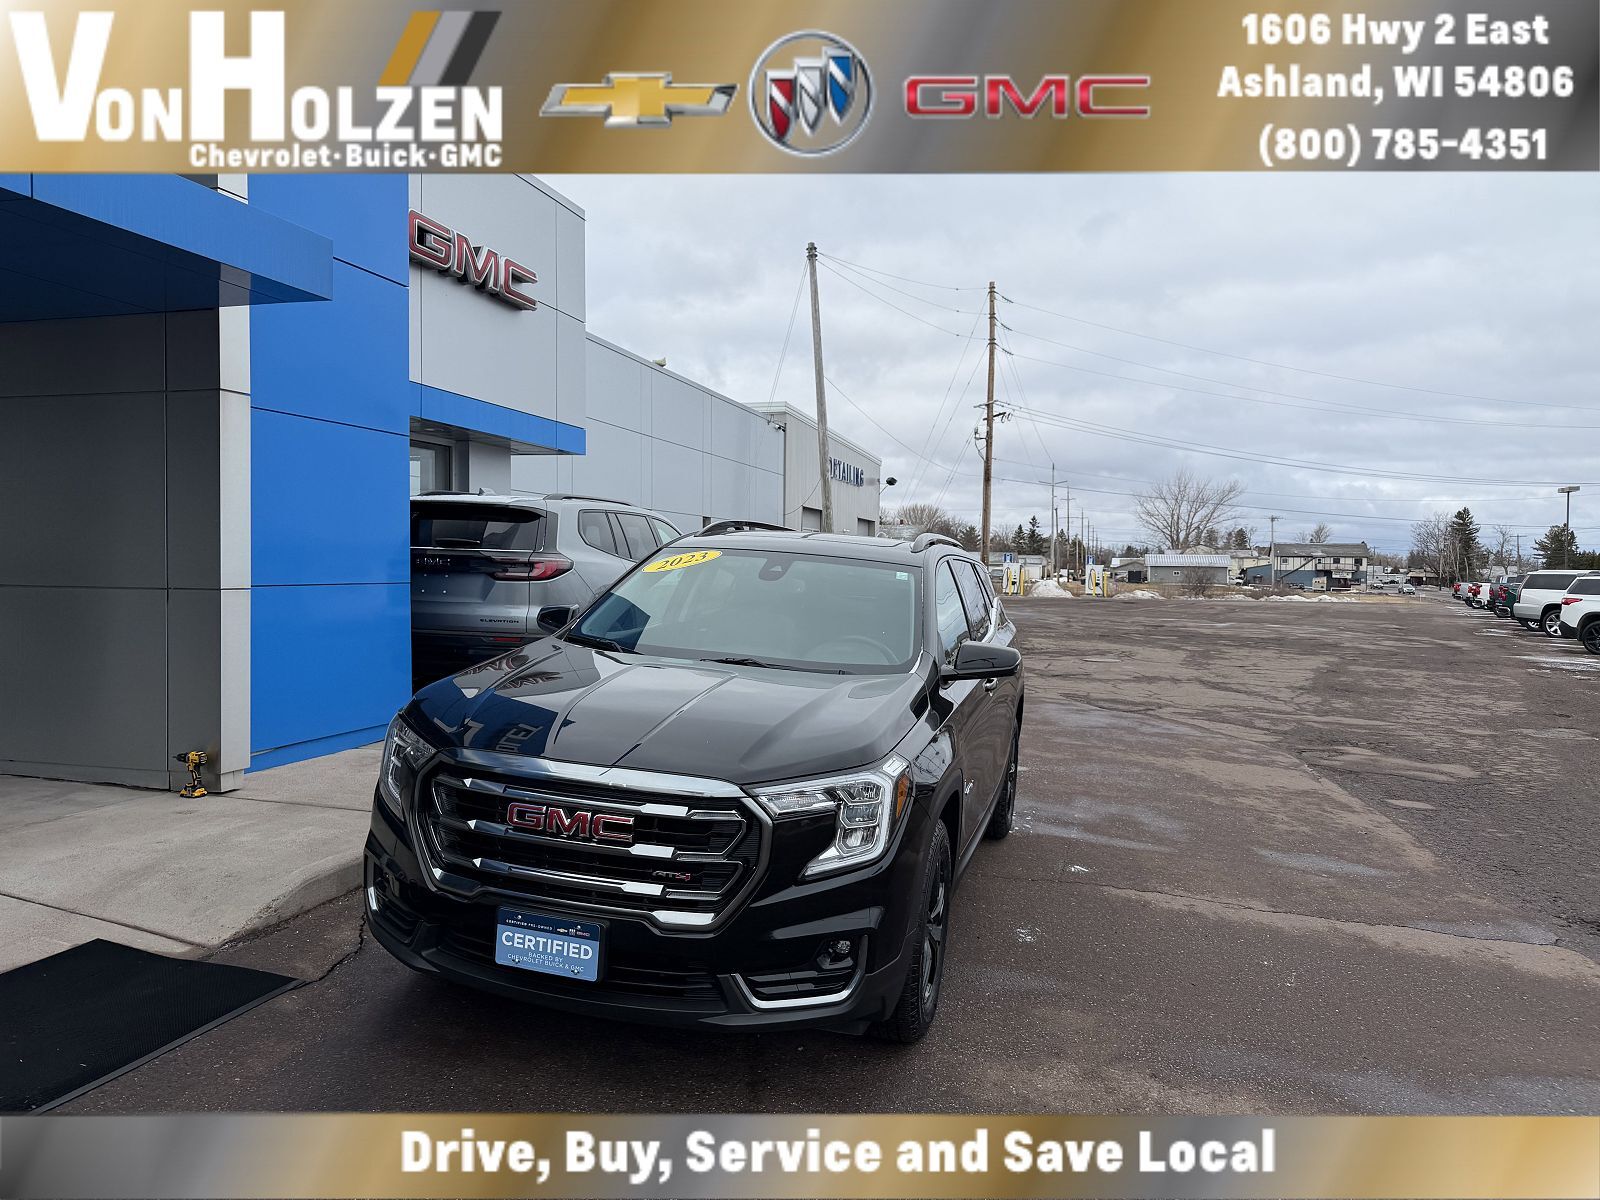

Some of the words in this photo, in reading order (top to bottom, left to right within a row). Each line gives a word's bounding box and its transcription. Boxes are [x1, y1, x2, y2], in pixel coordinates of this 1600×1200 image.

[408, 208, 539, 311] GMC
[655, 551, 709, 571] 2023
[506, 801, 635, 843] GMC
[501, 931, 593, 960] CERTIFIED
[528, 951, 553, 961] BACKED
[507, 953, 543, 965] CHEVROLET
[544, 960, 564, 968] BUICK
[570, 964, 585, 972] GMC
